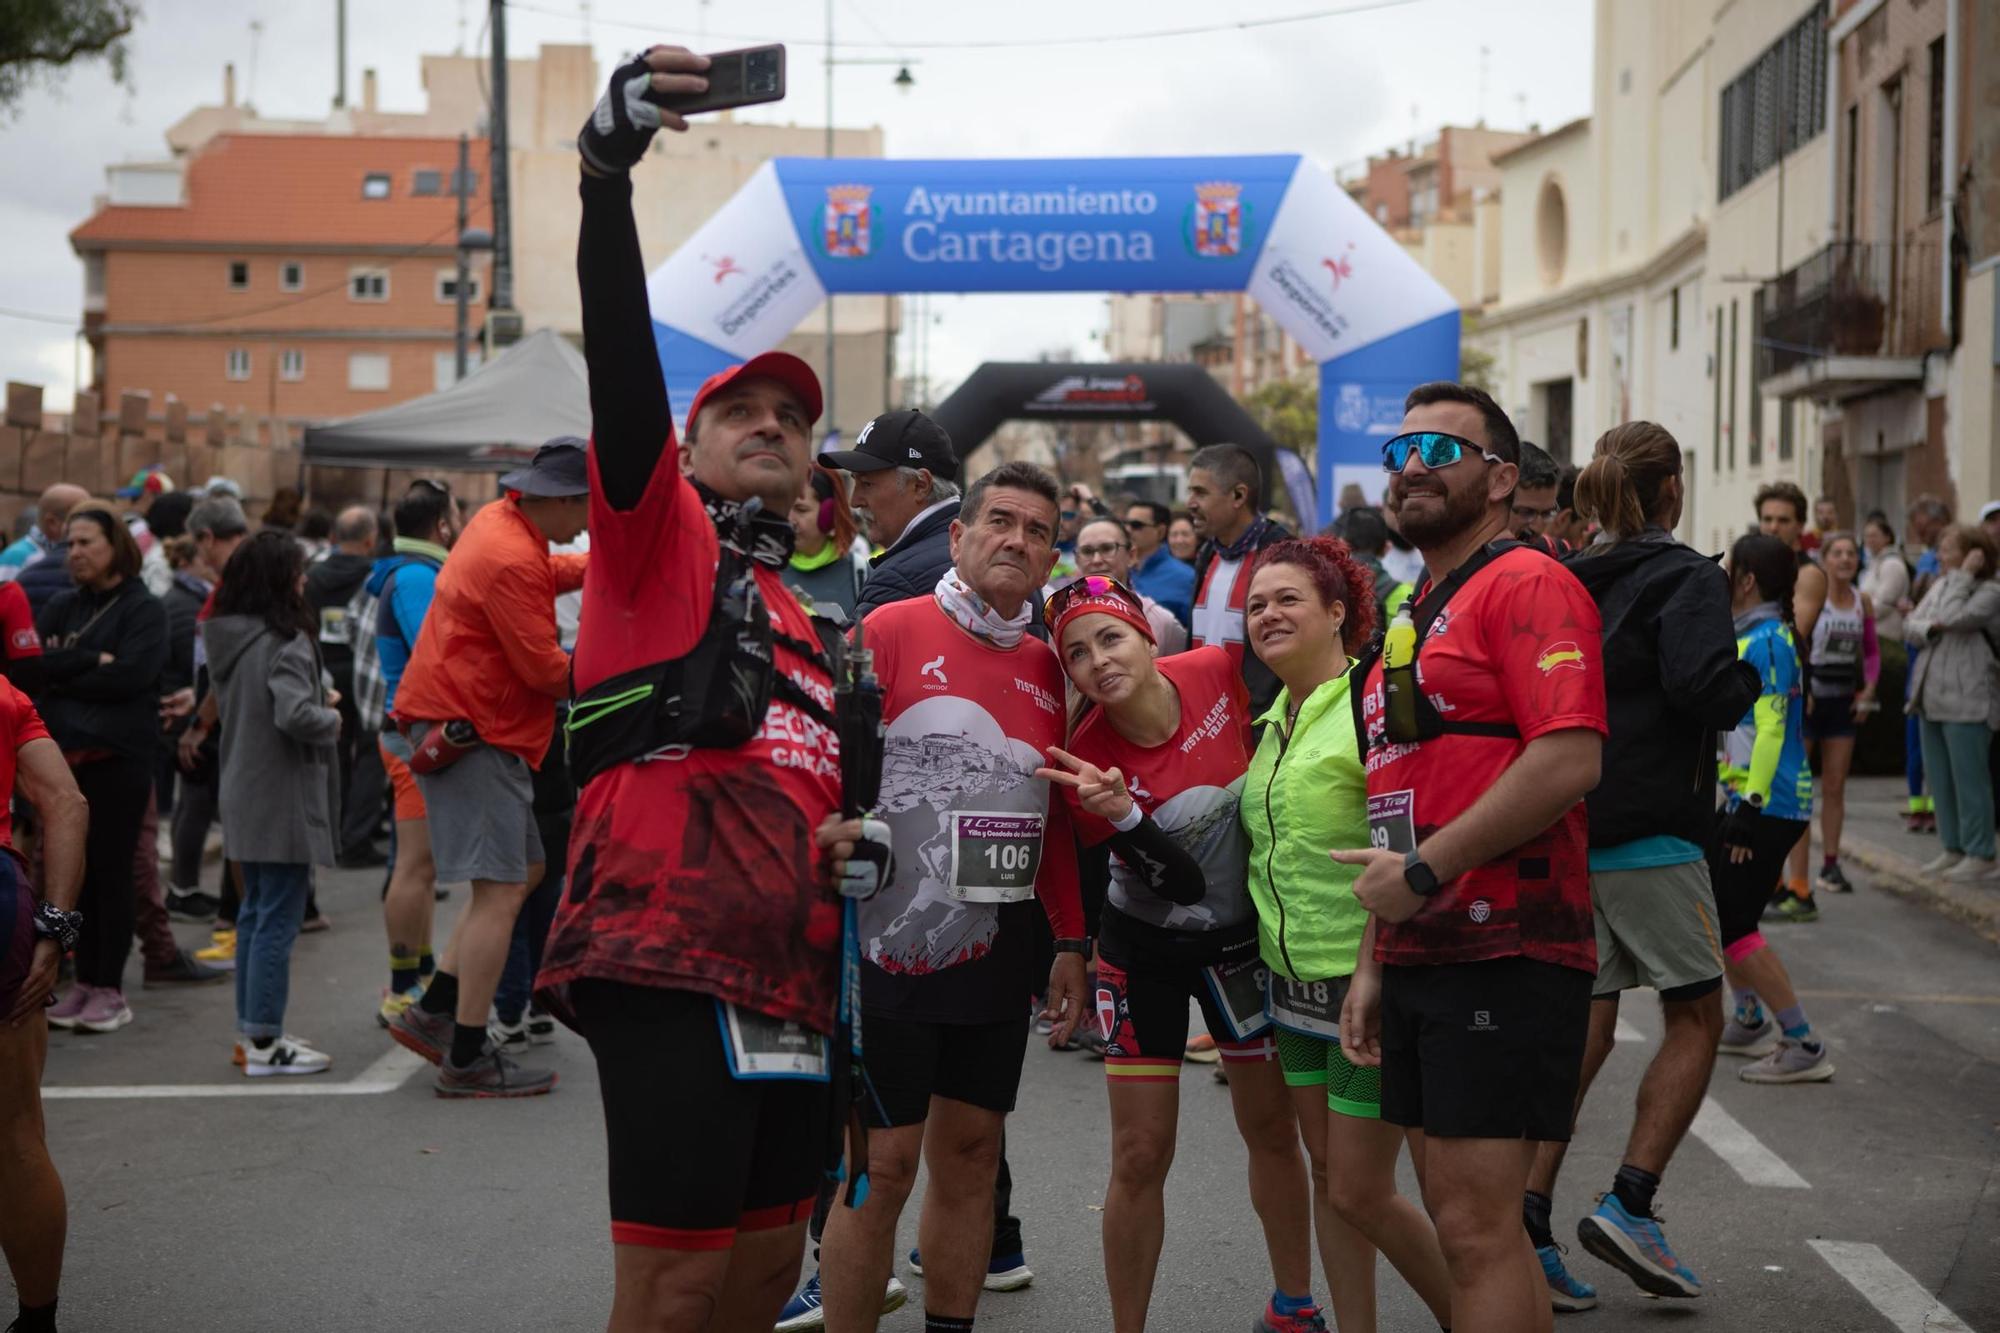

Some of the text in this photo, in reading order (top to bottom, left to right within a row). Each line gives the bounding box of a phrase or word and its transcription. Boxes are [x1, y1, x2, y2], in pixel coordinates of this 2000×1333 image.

[903, 184, 1158, 223] Ayuntamiento
[902, 220, 1156, 271] Cartagena
[721, 268, 797, 337] Deportes
[1014, 677, 1041, 697] VISTA
[1180, 726, 1206, 754] VISTA
[1207, 713, 1230, 739] TRAIL
[975, 818, 1021, 829] Cross
[984, 843, 1030, 870] 106
[1284, 977, 1329, 1005] 118
